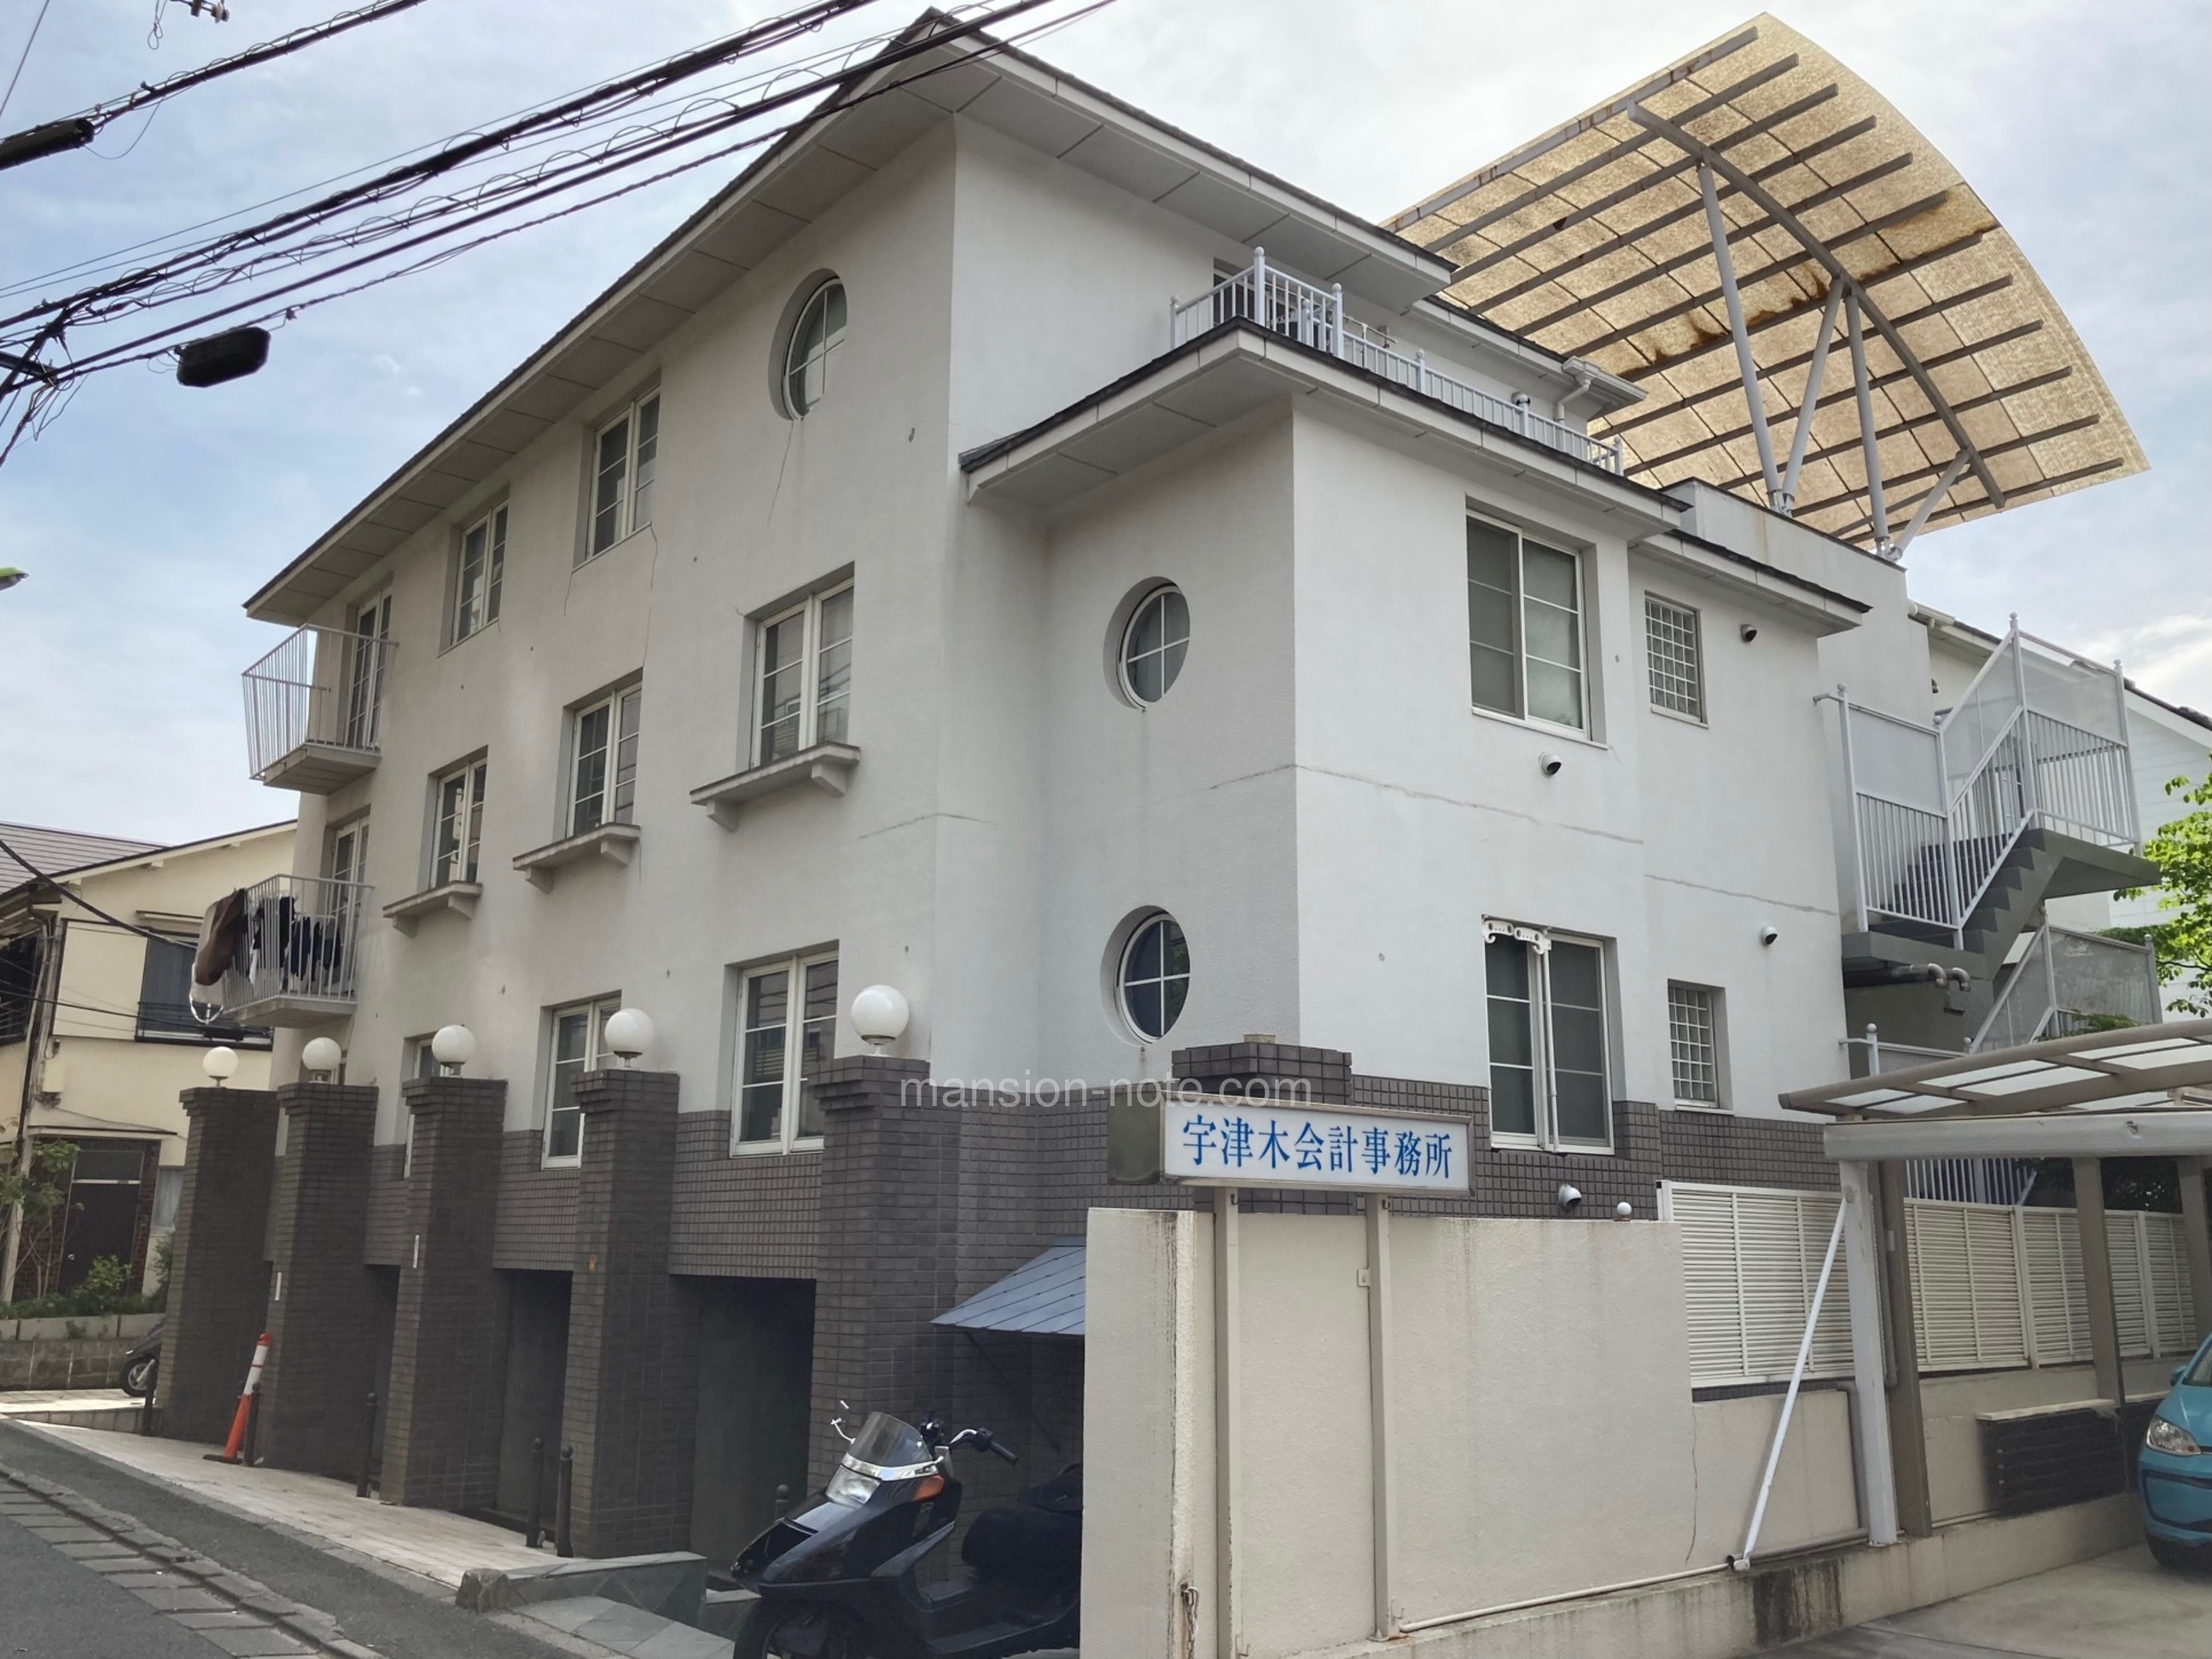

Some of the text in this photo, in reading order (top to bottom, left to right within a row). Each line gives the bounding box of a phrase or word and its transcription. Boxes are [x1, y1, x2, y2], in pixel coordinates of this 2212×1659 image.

[1183, 1114, 1452, 1179] 宇津木会計事務所
